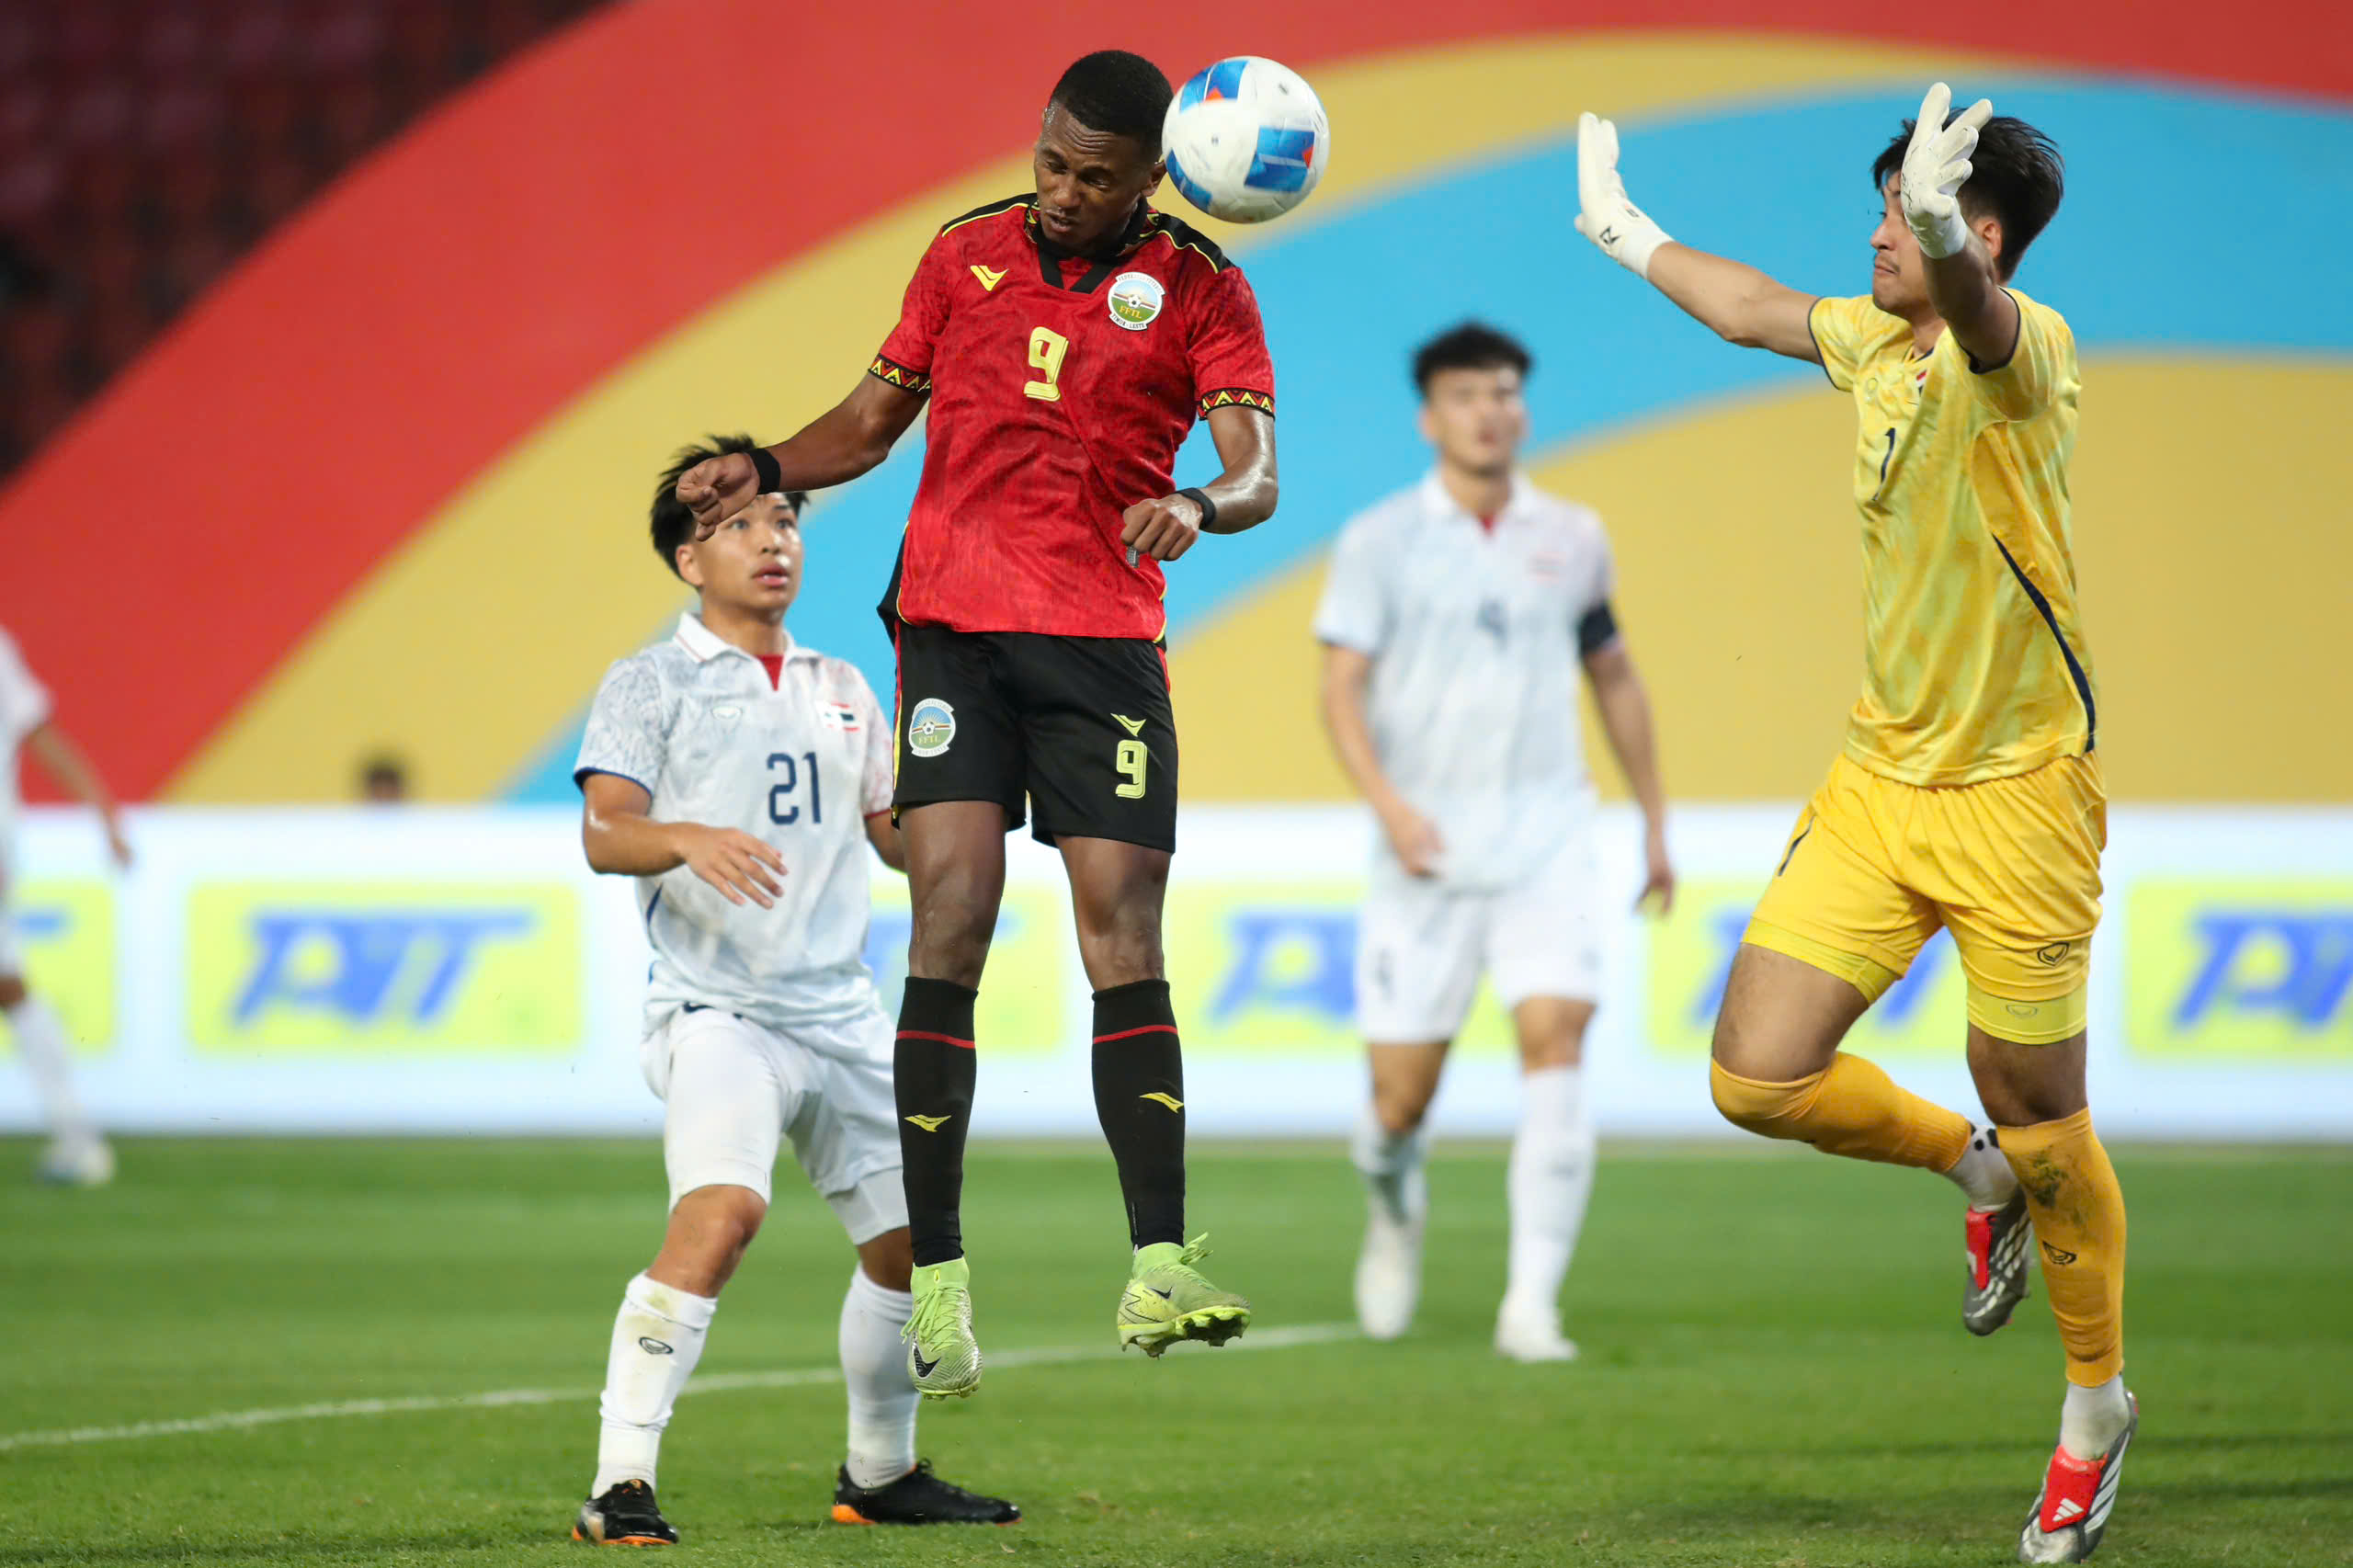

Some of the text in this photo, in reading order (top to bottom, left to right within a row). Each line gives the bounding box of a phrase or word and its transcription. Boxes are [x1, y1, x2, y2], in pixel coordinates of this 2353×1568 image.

[1023, 326, 1070, 403] 9
[766, 751, 822, 825] 21
[1115, 739, 1148, 800] 9
